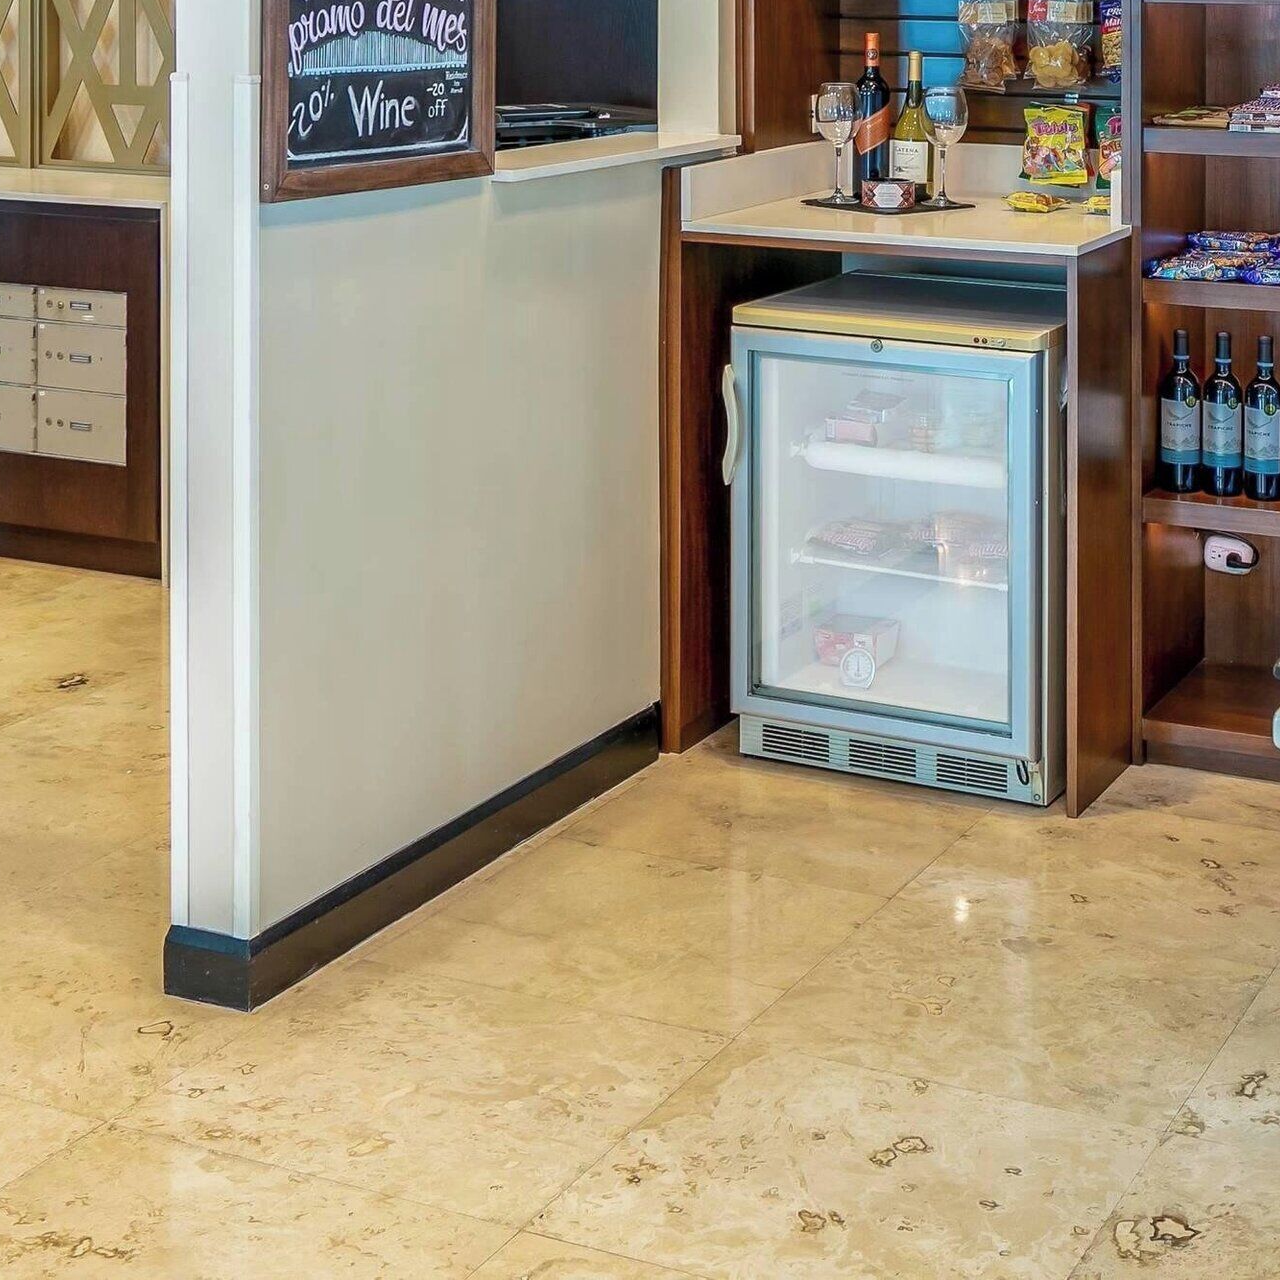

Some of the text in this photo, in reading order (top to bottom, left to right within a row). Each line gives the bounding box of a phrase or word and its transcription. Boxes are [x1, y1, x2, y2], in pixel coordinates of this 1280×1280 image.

[288, 1, 365, 75] promo
[423, 2, 467, 52] mes
[347, 79, 416, 137] Wine
[428, 99, 448, 118] off
